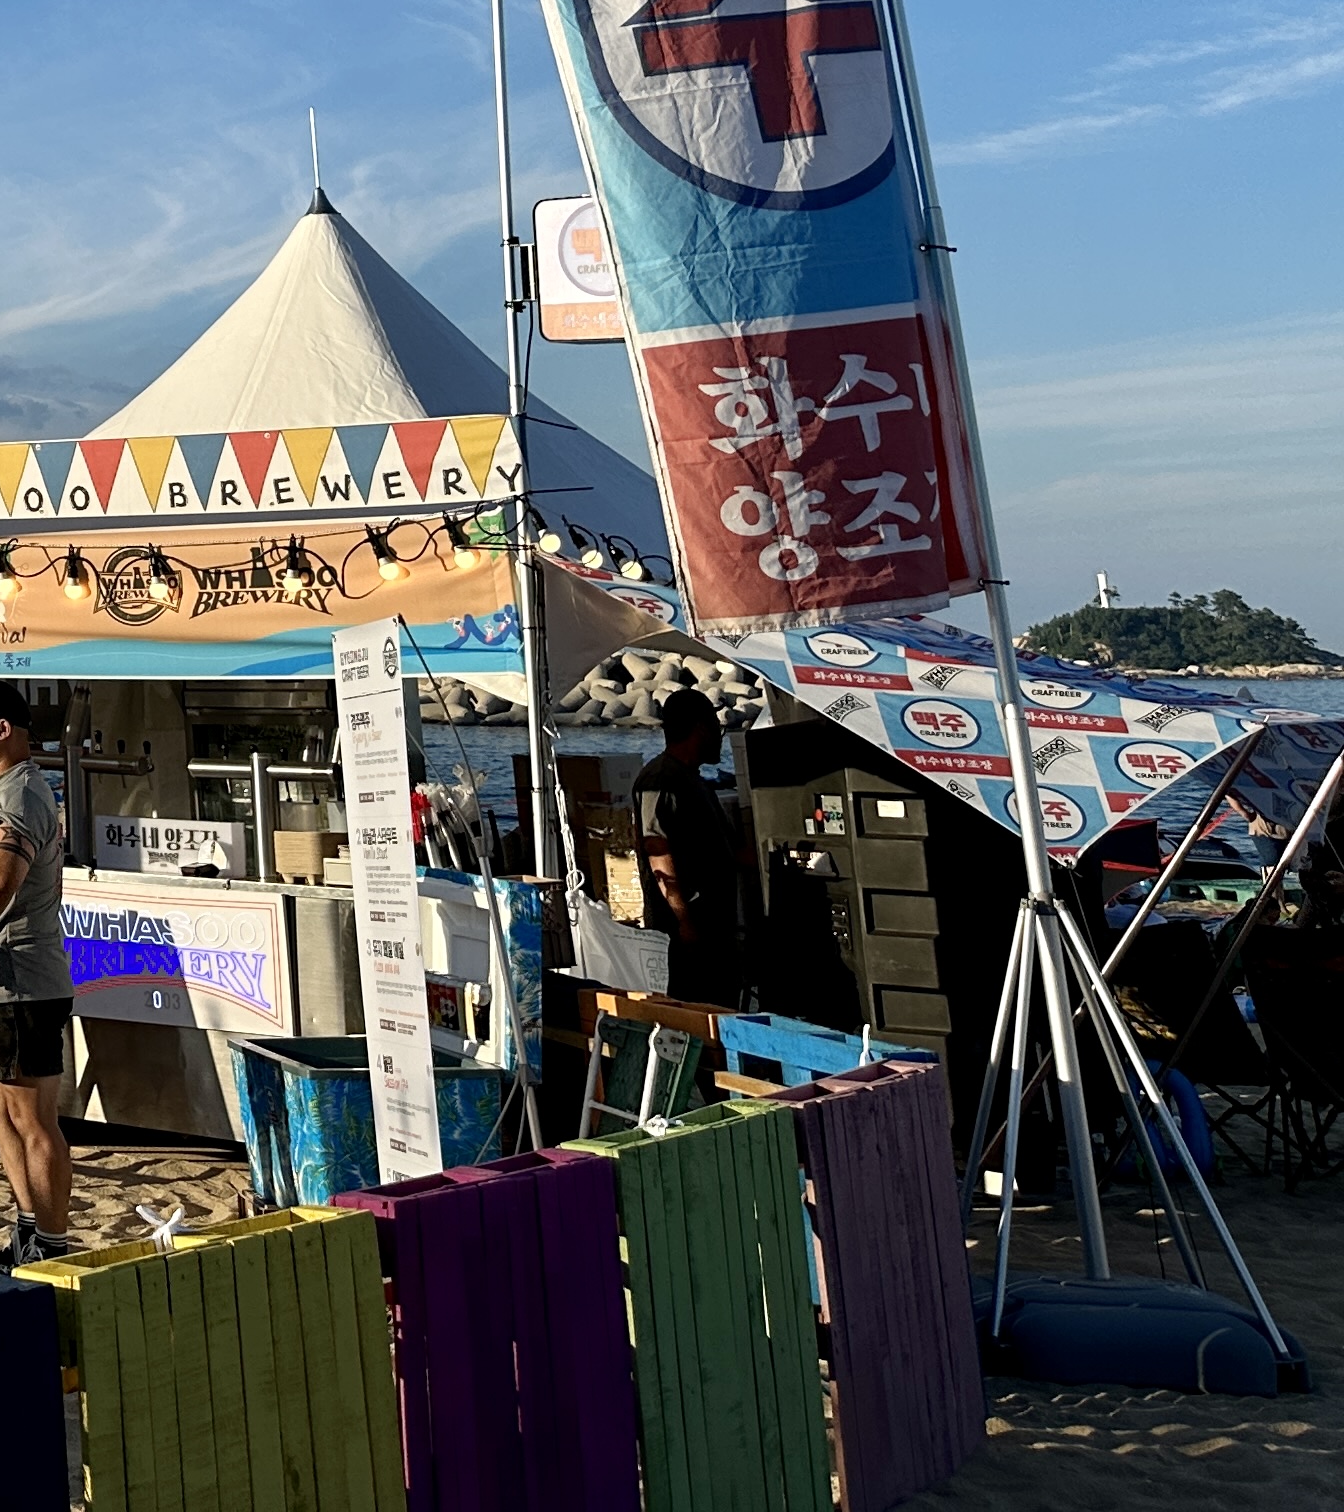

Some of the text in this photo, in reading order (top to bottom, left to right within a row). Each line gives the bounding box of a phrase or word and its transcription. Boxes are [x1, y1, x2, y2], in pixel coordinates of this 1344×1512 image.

[571, 226, 603, 263] 맥
[167, 463, 522, 509] BREWERY
[190, 588, 334, 619] BREWERY
[820, 647, 870, 656] CRAFTBEER
[1031, 688, 1082, 698] CRAFTBEER
[911, 710, 967, 732] 맥주
[919, 729, 968, 739] CRAFTBEER
[1125, 753, 1187, 774] 맥주
[1042, 801, 1072, 822] 주
[105, 824, 160, 850] 화수네
[59, 900, 267, 952] WHASOO
[63, 938, 272, 1010] BREWERY
[144, 990, 181, 1010] 2003
